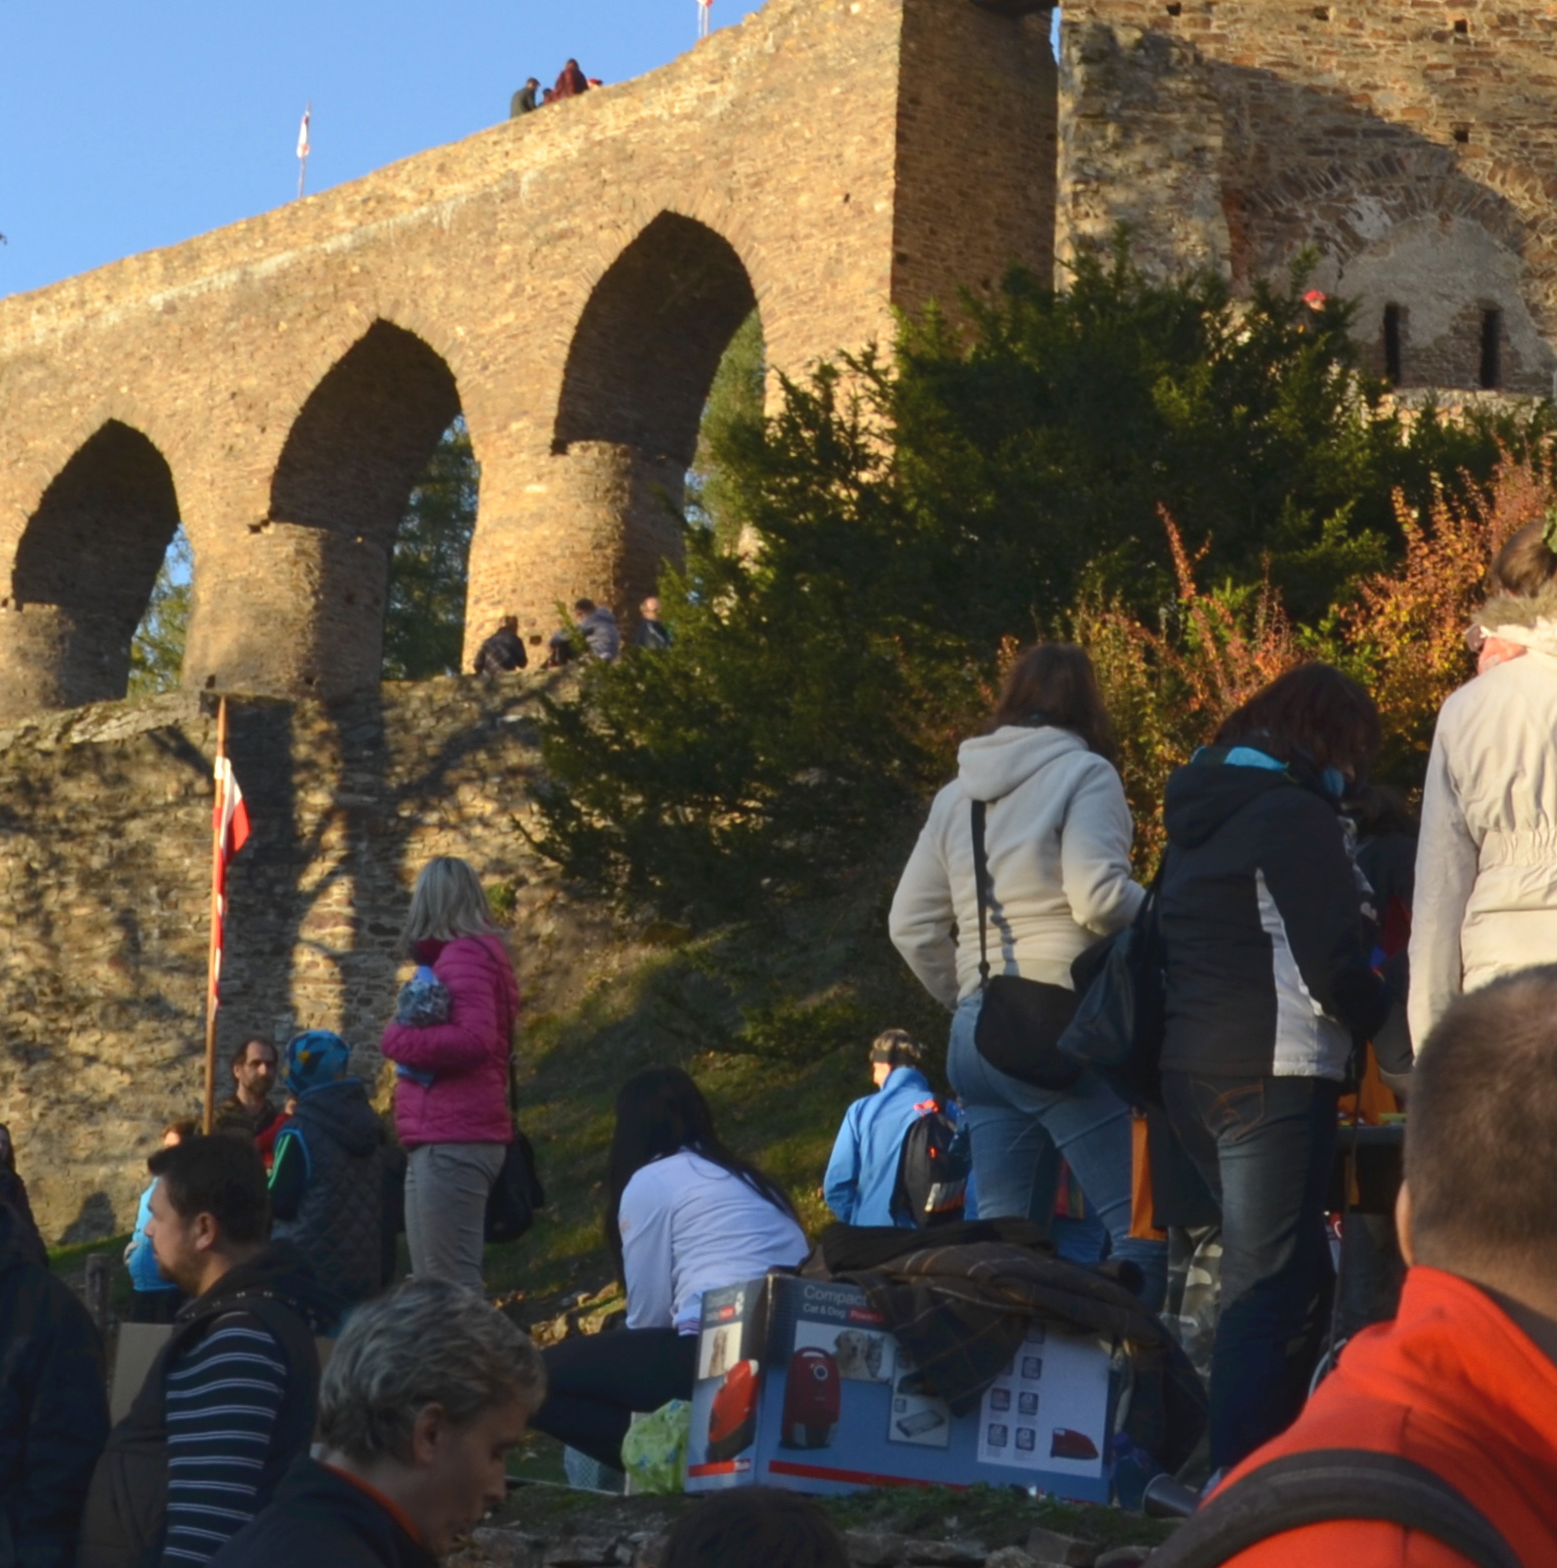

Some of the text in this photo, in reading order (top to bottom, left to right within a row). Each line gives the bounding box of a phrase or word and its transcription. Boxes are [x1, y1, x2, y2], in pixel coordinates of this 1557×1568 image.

[804, 1285, 867, 1306] Compact
[803, 1303, 819, 1313] Cat
[827, 1306, 846, 1319] Dog
